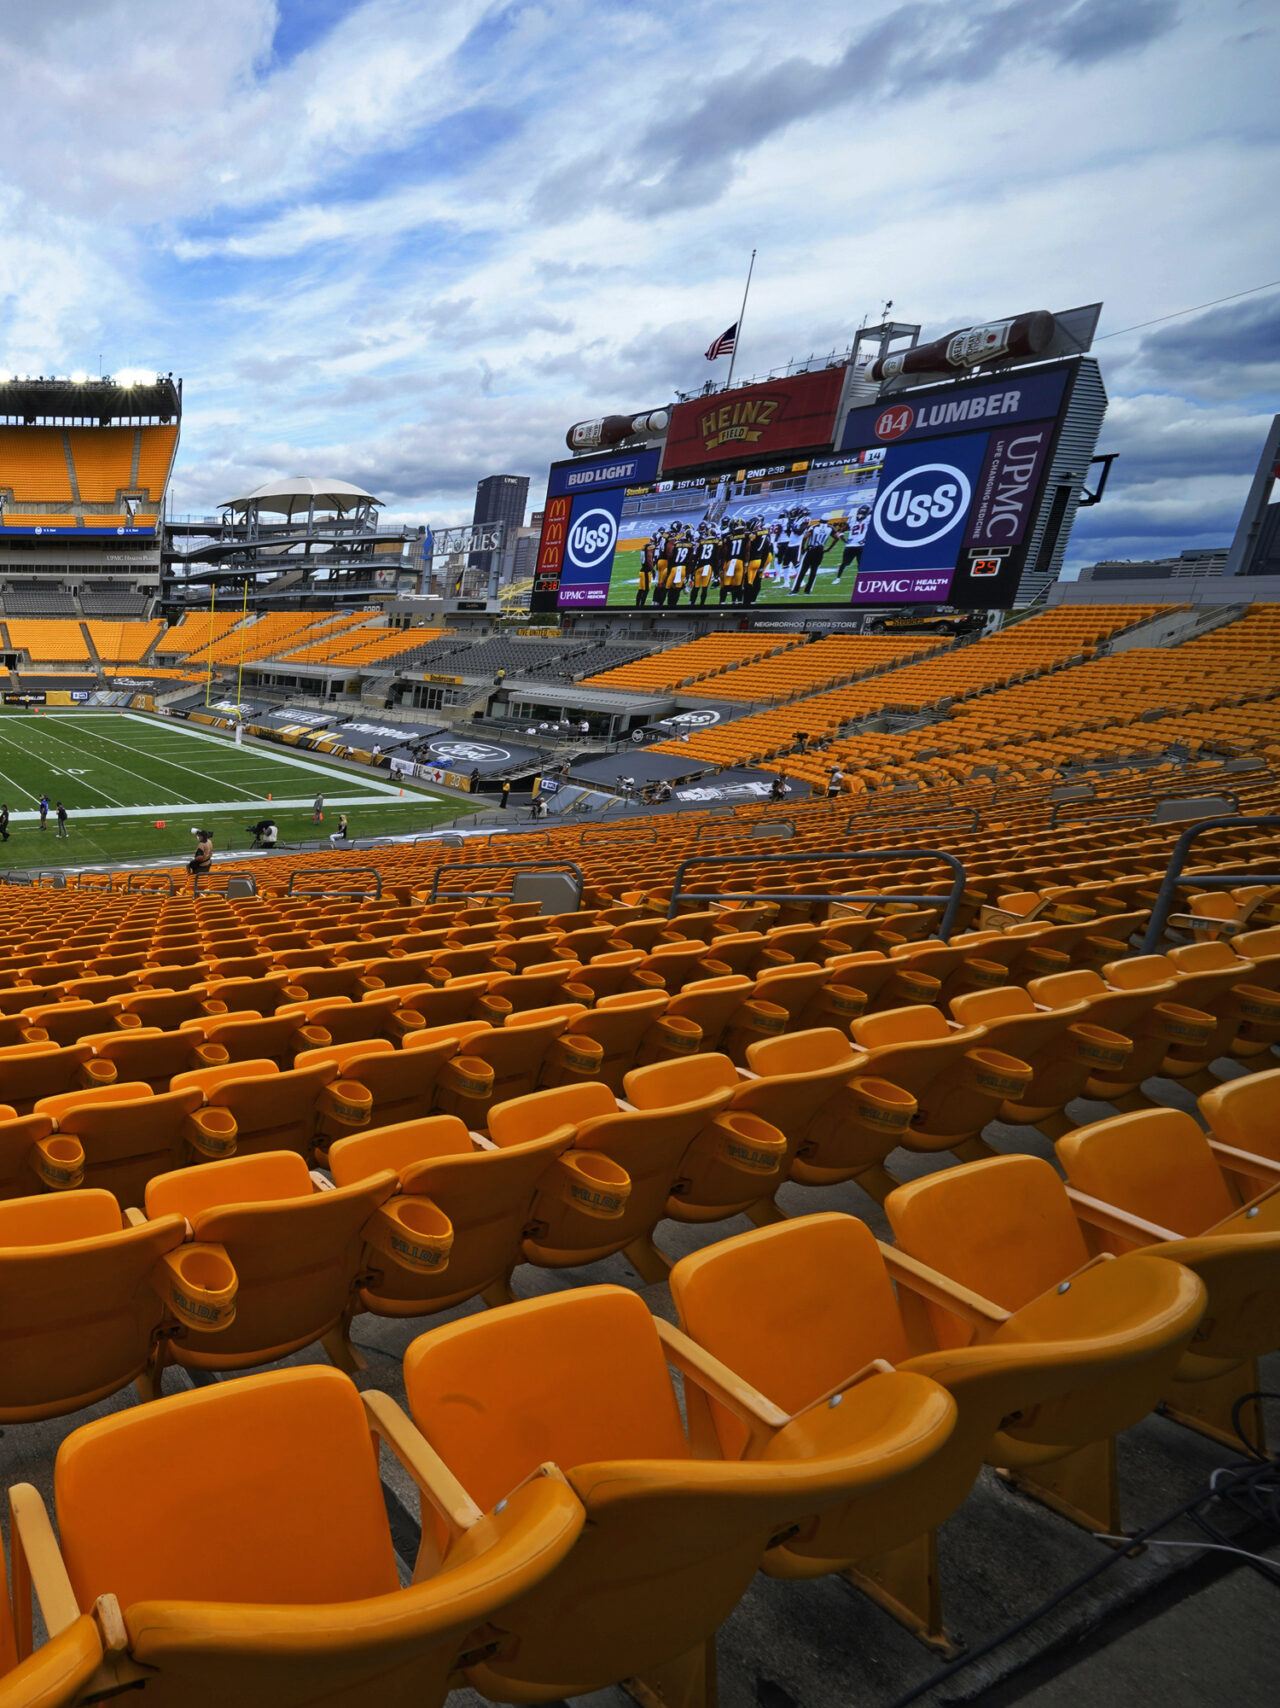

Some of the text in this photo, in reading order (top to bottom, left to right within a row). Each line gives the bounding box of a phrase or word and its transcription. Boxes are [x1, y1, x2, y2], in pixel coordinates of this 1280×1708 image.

[701, 400, 779, 437] HEINZ
[878, 391, 1021, 436] 84 LUMBER
[721, 428, 745, 441] FIELD
[568, 463, 634, 486] BUD LIGHT
[661, 482, 671, 491] 10
[694, 477, 705, 486] 10
[720, 473, 731, 483] 37
[747, 468, 766, 479] 2ND
[815, 458, 858, 469] TEXANS
[869, 451, 881, 461] 14
[972, 440, 1005, 539] LIFE CHANGING MEDICINE
[985, 432, 1043, 538] UPMC
[886, 483, 958, 528] USS
[851, 523, 865, 535] 21
[435, 532, 500, 555] PEOPLES
[574, 522, 611, 554] USS
[677, 547, 688, 563] 19
[701, 543, 713, 560] 13
[731, 540, 742, 555] 11
[974, 560, 997, 574] 25
[541, 581, 558, 590] 2:38
[857, 578, 948, 594] UPMC HEALTH
[914, 584, 937, 592] PLAN
[560, 591, 586, 600] UPMC
[363, 605, 381, 613] FORD
[754, 621, 811, 629] NEIGHBORHOOD
[832, 621, 857, 629] STORE
[137, 694, 146, 709] 33
[450, 774, 461, 787] 33
